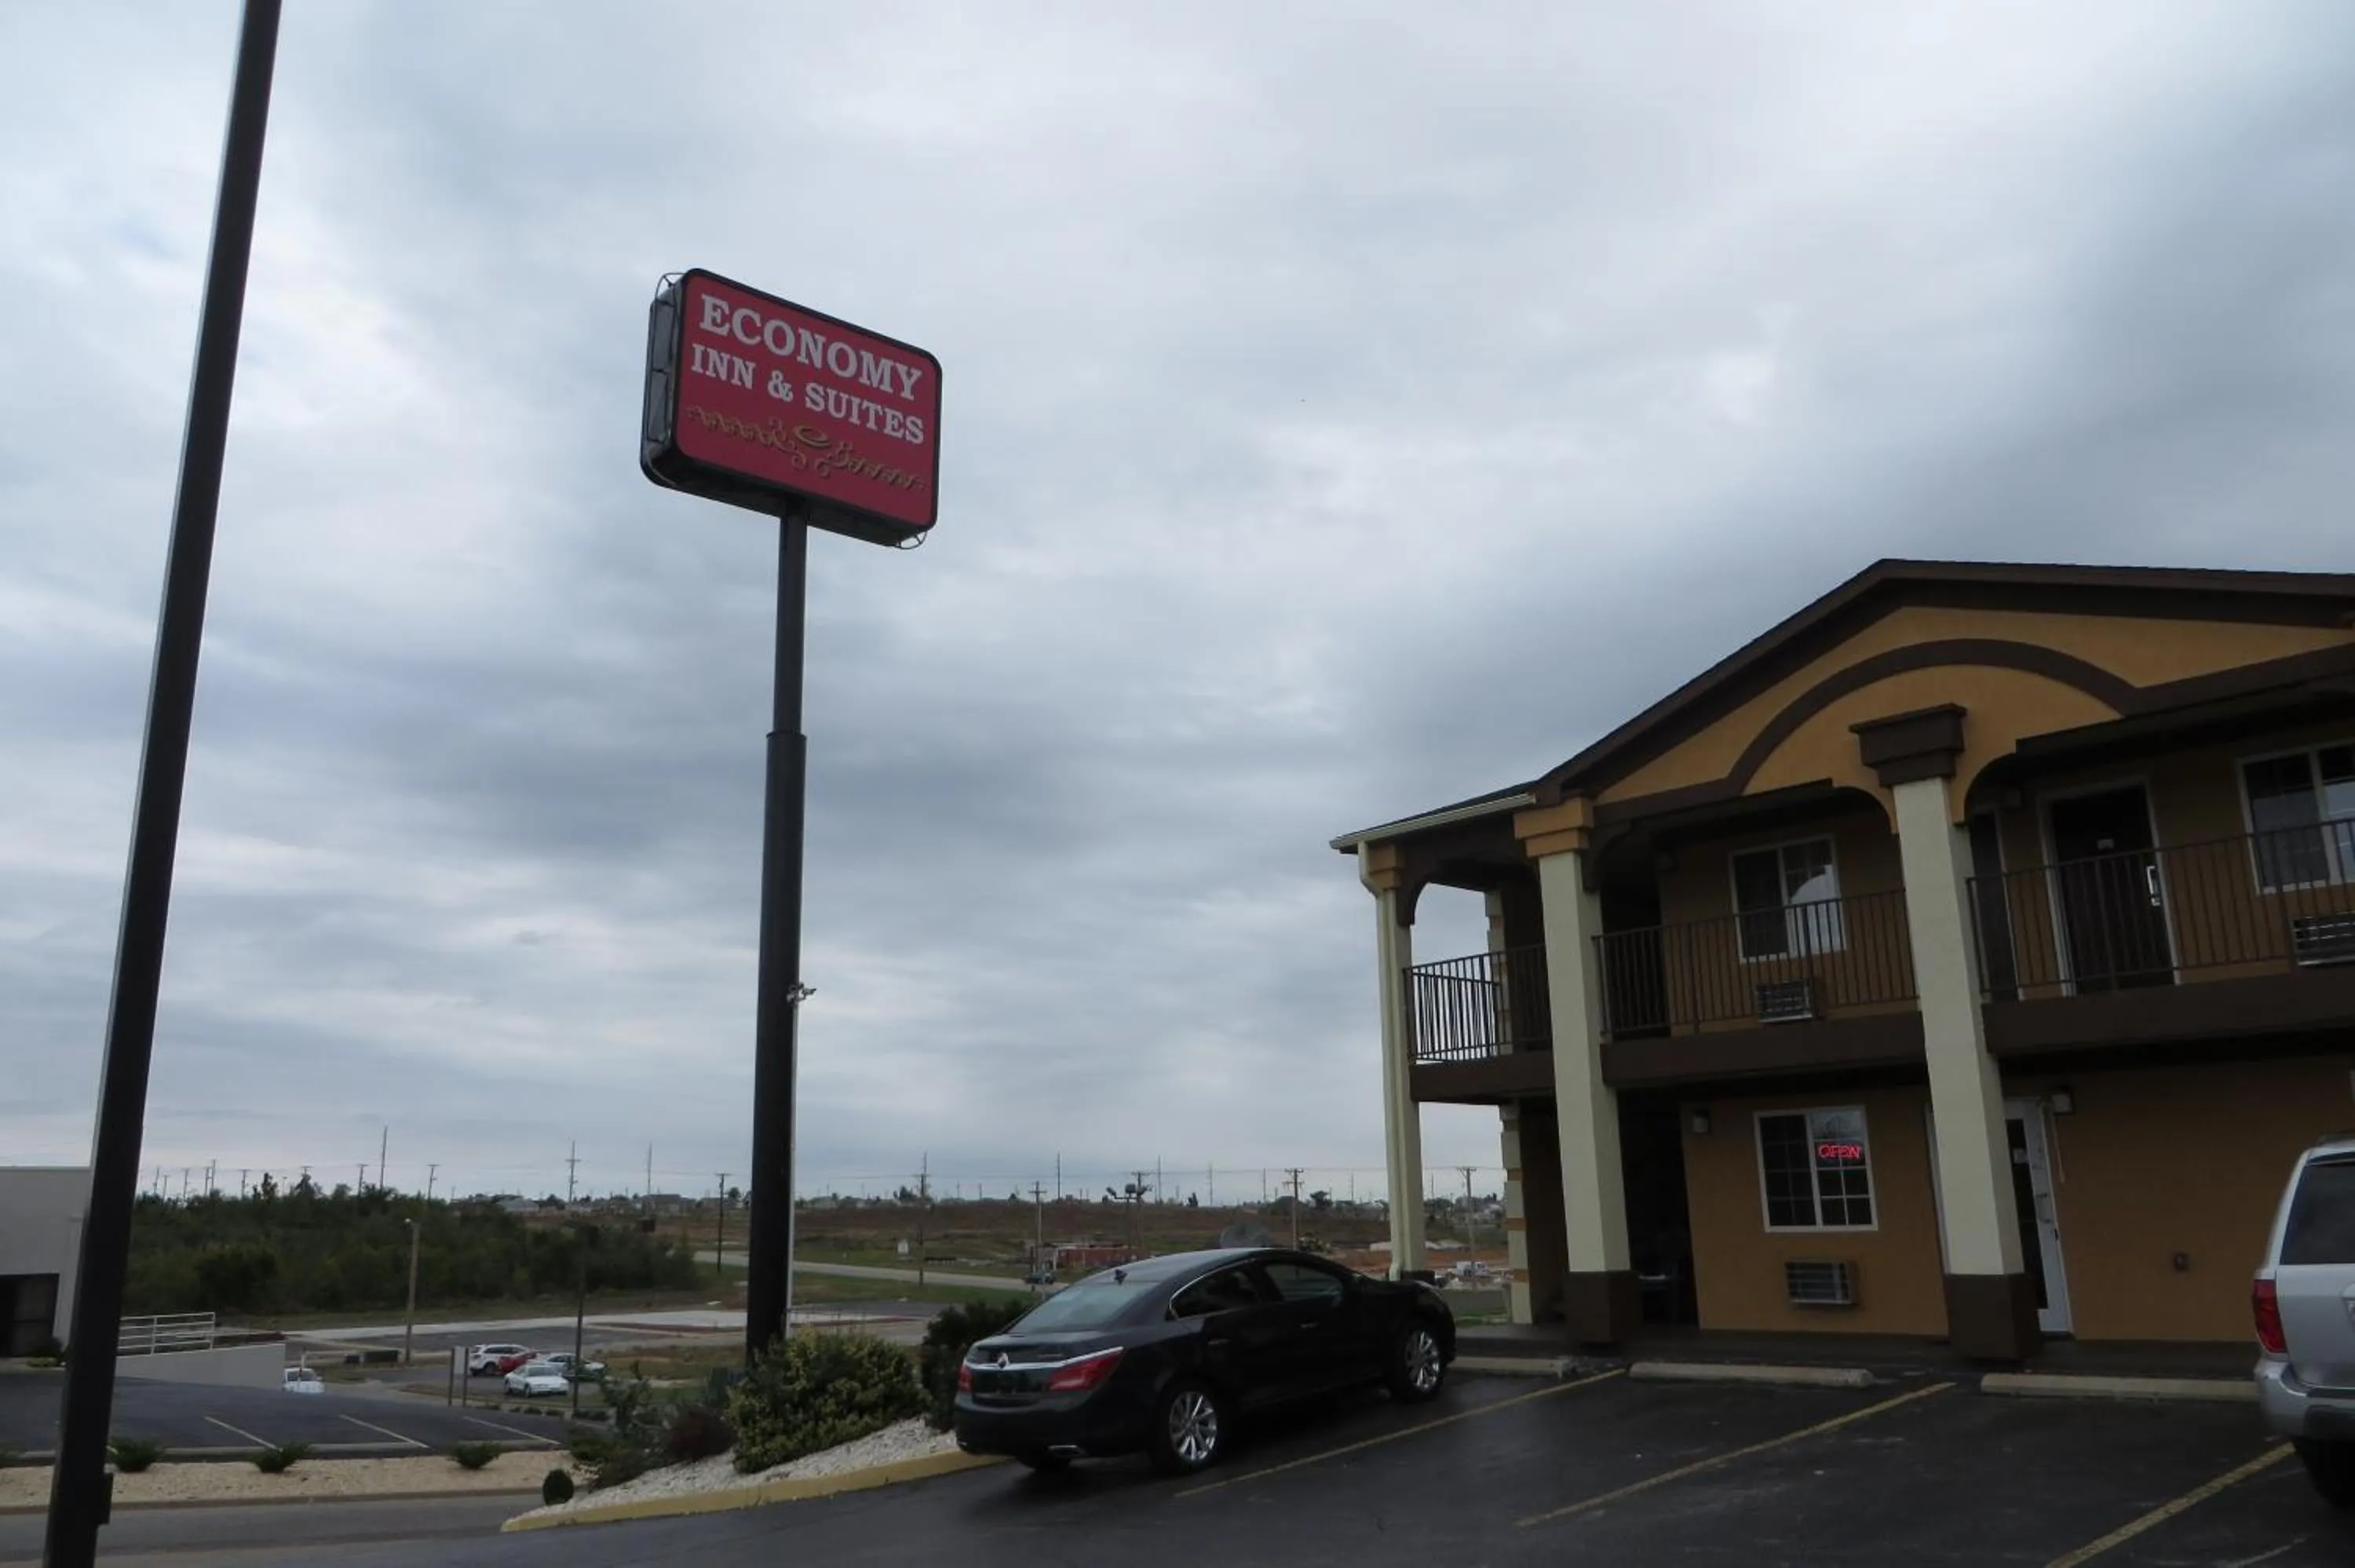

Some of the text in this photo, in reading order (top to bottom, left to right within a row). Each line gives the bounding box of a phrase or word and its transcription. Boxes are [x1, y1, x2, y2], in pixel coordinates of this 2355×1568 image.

[692, 344, 923, 444] INN & SUITES
[701, 294, 922, 400] ECONOMY
[1818, 1145, 1860, 1159] OPEN
